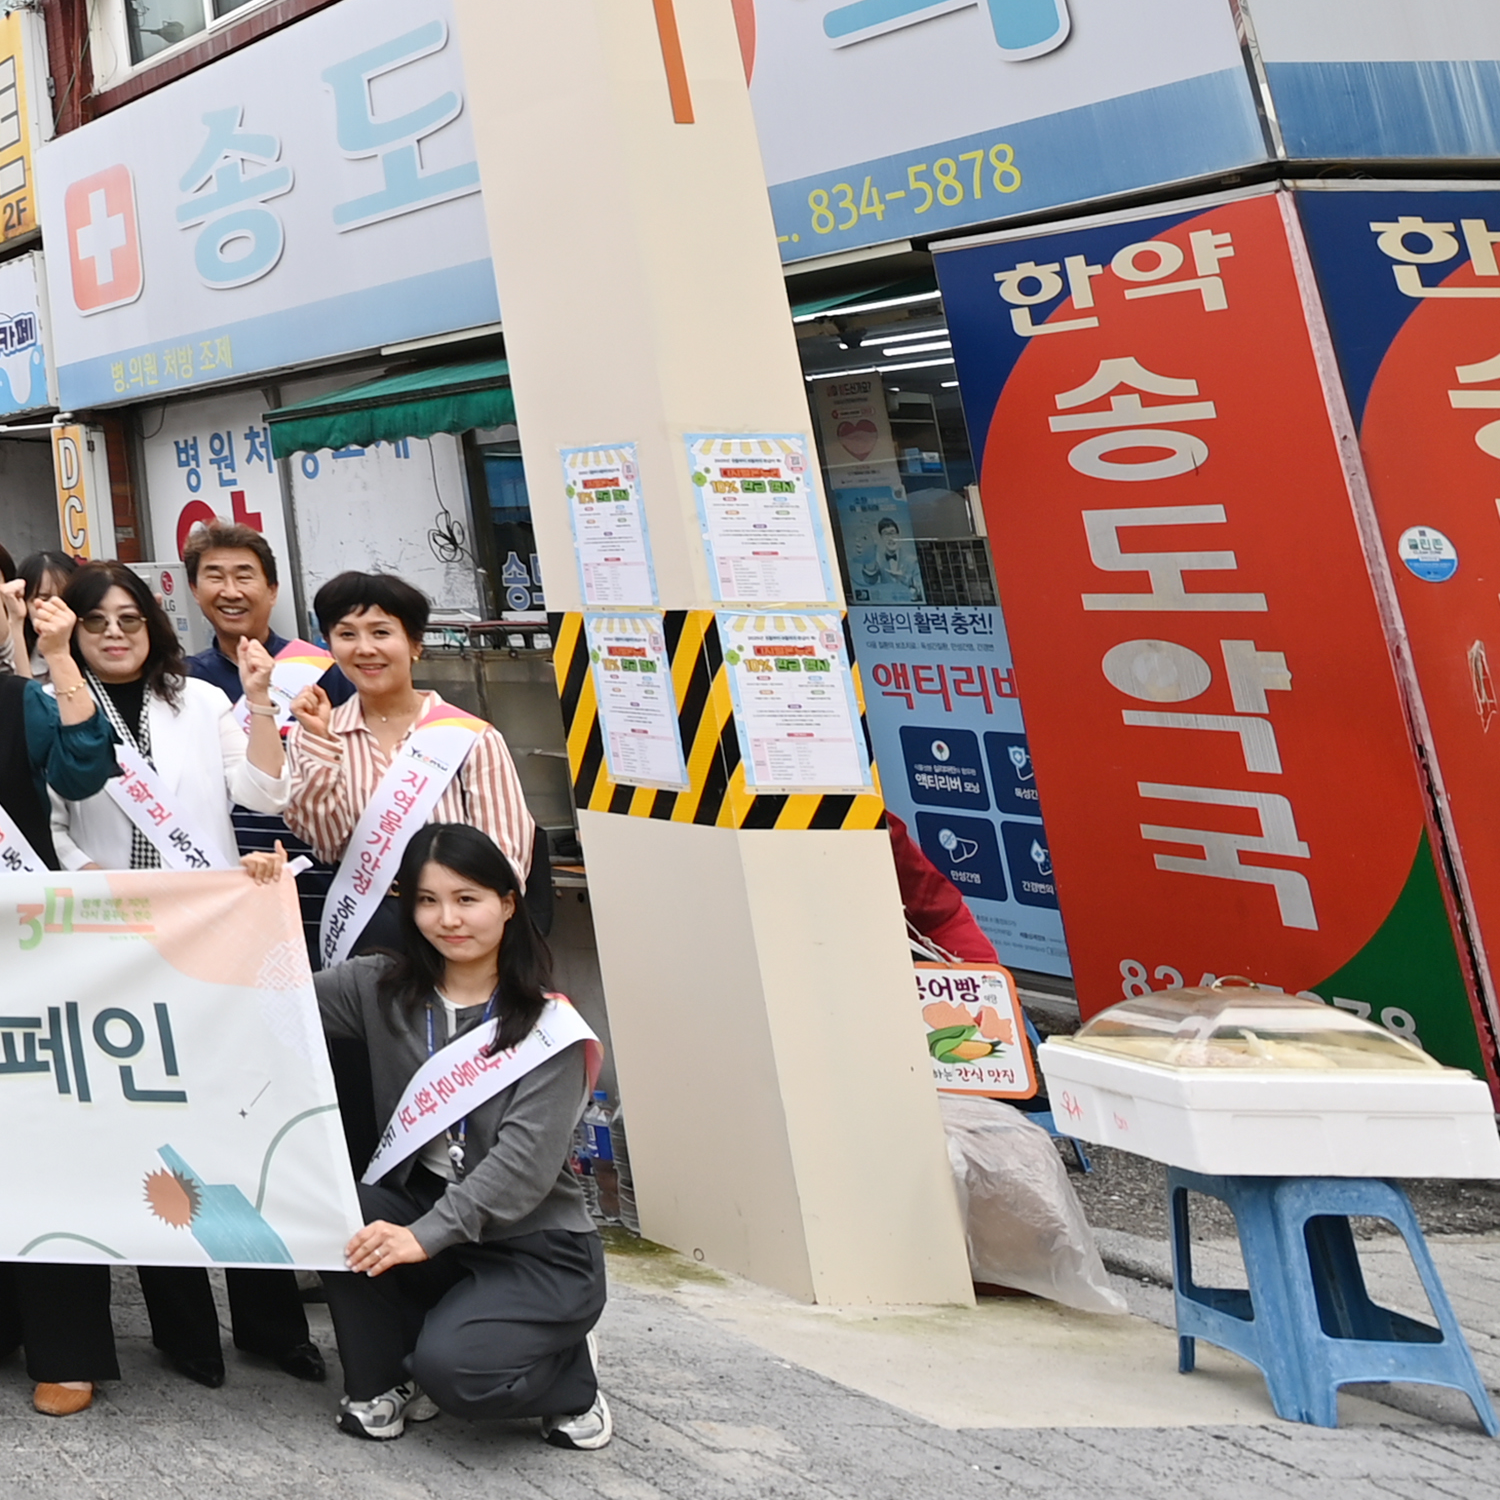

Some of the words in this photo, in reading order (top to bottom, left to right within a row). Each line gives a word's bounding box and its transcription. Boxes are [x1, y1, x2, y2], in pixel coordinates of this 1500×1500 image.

[175, 14, 483, 290] 송도
[808, 142, 1022, 236] 834-5878
[2, 196, 28, 234] 2F
[992, 228, 1236, 338] 한약
[163, 345, 194, 376] 처방
[200, 334, 233, 372] 조제
[863, 612, 913, 634] 생활의
[915, 612, 949, 635] 활력
[951, 612, 993, 636] 충전!
[1047, 356, 1320, 931] 송도약국
[915, 773, 963, 793] 액티리버
[955, 1067, 985, 1083] 간식
[987, 1069, 1015, 1084] 맛집
